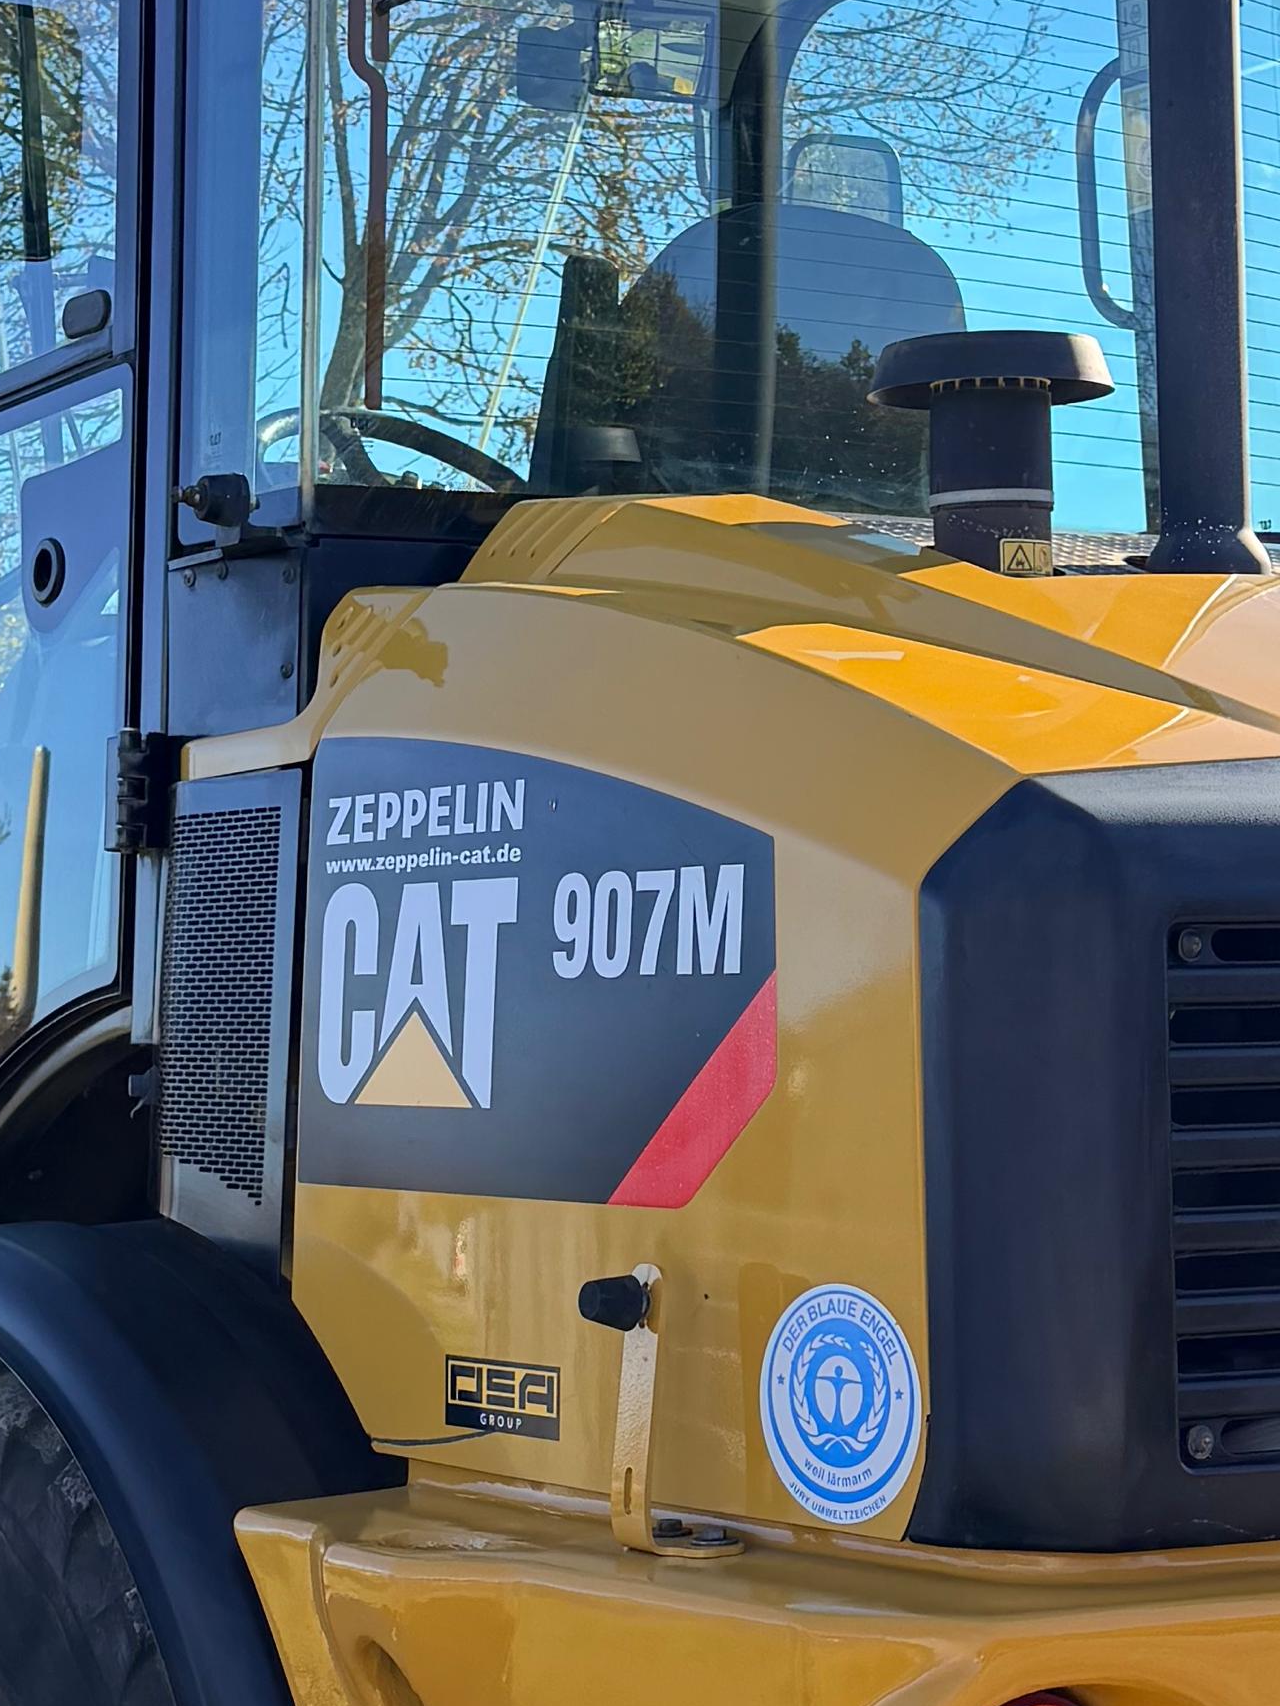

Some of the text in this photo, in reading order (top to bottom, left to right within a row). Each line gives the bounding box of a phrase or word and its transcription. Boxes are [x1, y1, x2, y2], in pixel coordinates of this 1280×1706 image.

[326, 779, 525, 845] ZEPPELIN
[326, 843, 521, 873] www.zeppelin-cat.de
[552, 864, 745, 979] 907M
[318, 877, 518, 1109] CAT
[782, 1298, 899, 1366] DER BLAUE ENGEL
[480, 1413, 522, 1430] GROUP
